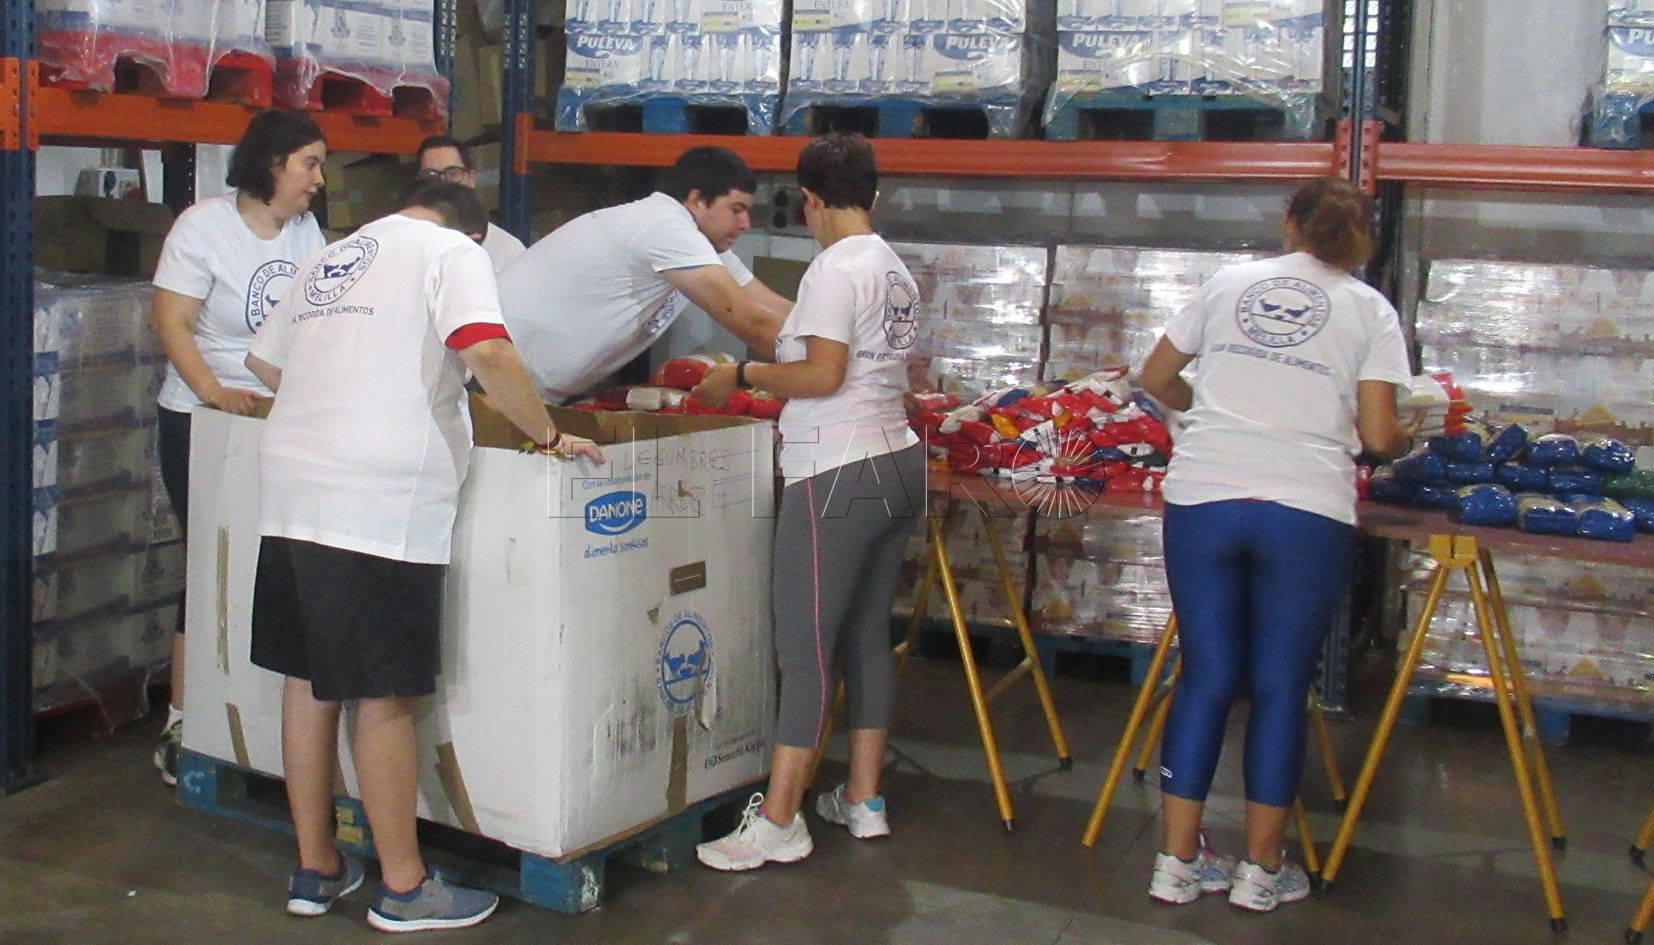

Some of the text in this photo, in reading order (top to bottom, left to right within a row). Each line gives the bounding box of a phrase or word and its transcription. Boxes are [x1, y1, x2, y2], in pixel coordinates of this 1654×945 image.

[576, 34, 640, 51] PULEVA
[945, 35, 1011, 51] PULEVA
[250, 274, 267, 317] BANCO
[262, 265, 277, 278] DE
[309, 285, 347, 303] MELILLA
[1239, 282, 1270, 314] BANCO
[334, 304, 375, 317] ALIMENTOS
[582, 478, 596, 490] Con
